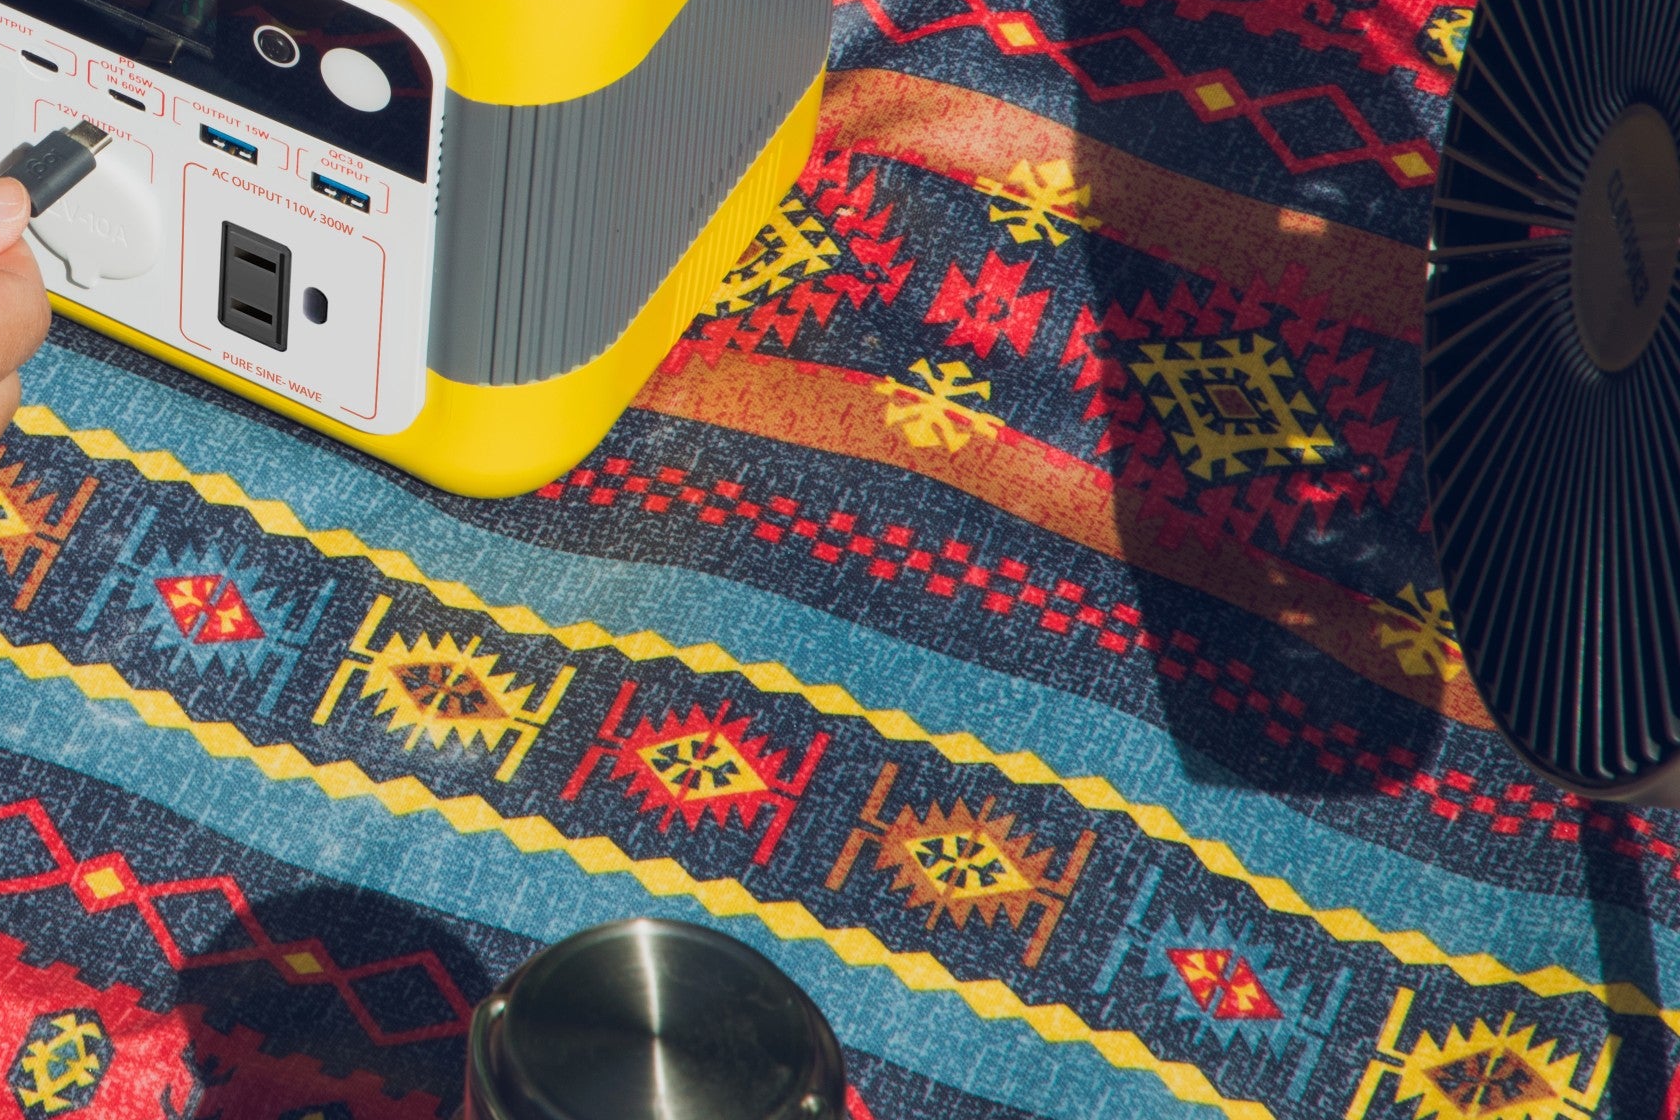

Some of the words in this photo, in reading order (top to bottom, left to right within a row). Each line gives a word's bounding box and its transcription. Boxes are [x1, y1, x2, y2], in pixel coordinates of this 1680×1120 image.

[100, 60, 125, 76] OUT
[128, 72, 154, 89] 65W
[119, 56, 135, 70] PD
[106, 74, 118, 86] IN
[121, 81, 146, 97] 60W
[56, 103, 78, 118] 12V
[192, 101, 241, 129] OUTPUT
[246, 124, 270, 140] 15W
[320, 157, 370, 184] OUTPUT
[328, 149, 364, 170] QC3.0
[212, 167, 229, 183] AC
[231, 176, 282, 205] OUTPUT
[285, 197, 318, 222] 110V,
[319, 213, 354, 236] 300W
[222, 351, 253, 373] PURE
[255, 366, 287, 386] SINE-
[288, 380, 322, 403] WAVE
